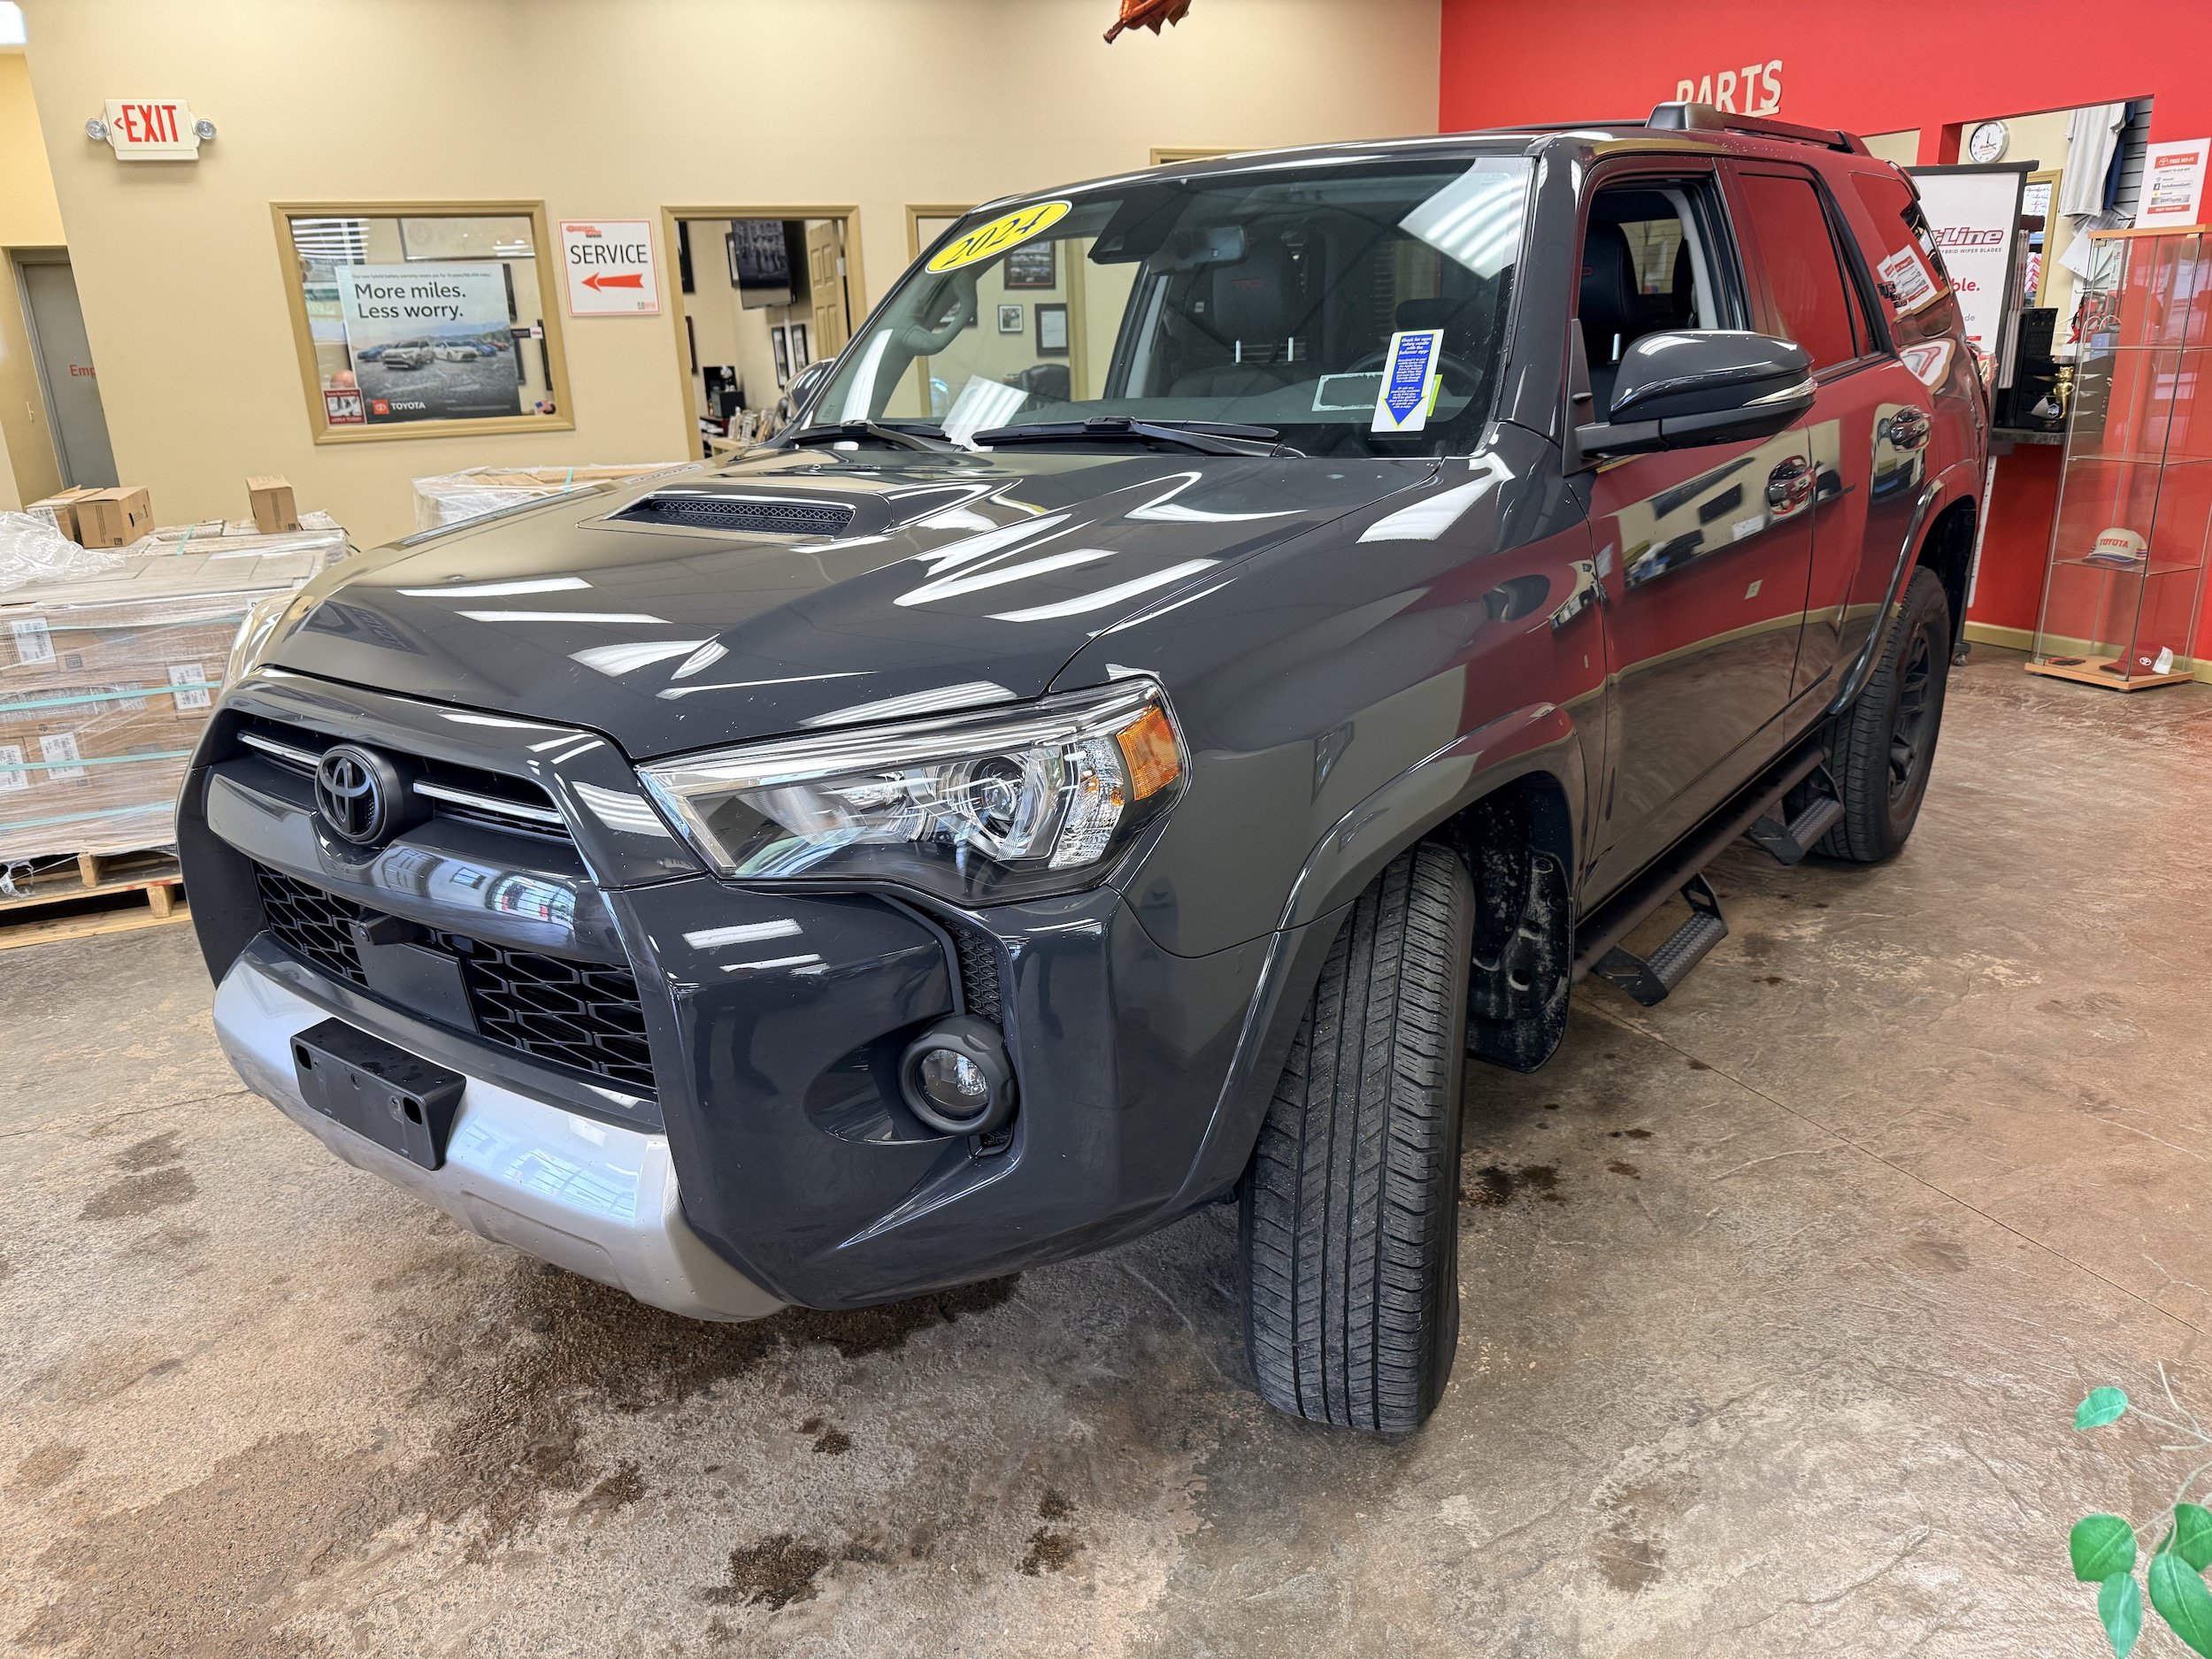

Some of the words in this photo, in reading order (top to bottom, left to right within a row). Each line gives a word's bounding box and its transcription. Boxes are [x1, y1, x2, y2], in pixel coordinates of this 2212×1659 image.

[1676, 59, 1783, 116] PARTS
[121, 104, 179, 142] EXIT
[941, 205, 1052, 269] 2024
[570, 243, 649, 265] SERVICE
[354, 283, 406, 299] More
[411, 281, 466, 298] miles.
[357, 303, 399, 319] Less
[403, 304, 464, 321] worry.
[390, 401, 426, 411] TOYOTA
[2100, 538, 2129, 549] TOYOTA
